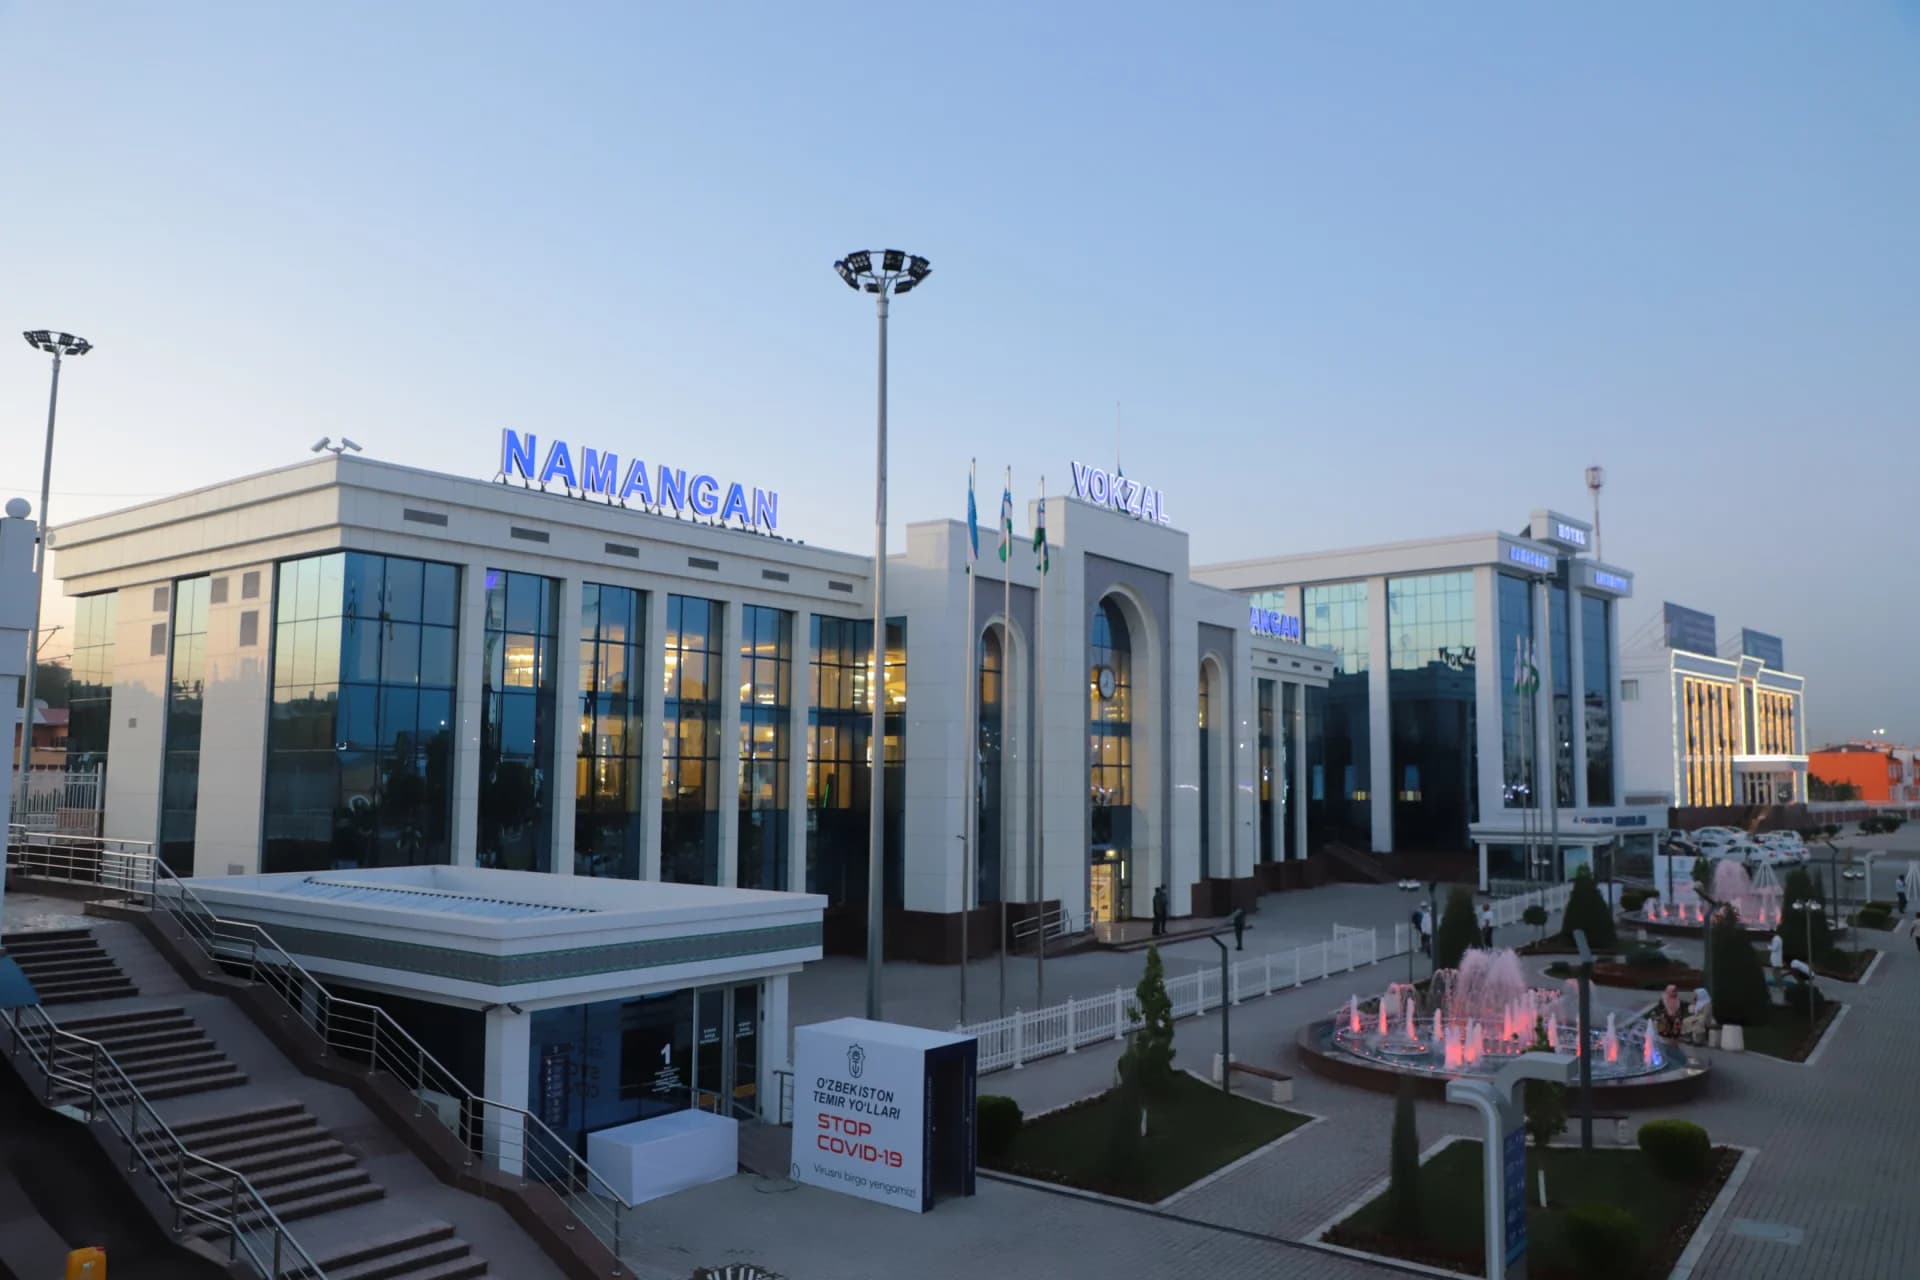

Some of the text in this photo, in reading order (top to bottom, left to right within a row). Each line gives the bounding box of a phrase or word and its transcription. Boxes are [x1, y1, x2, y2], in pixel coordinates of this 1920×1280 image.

[502, 428, 778, 529] NAMANGAN
[1071, 461, 1169, 523] VOKZAL
[1249, 607, 1299, 639] ANGAN
[660, 1043, 671, 1064] 1
[813, 1090, 901, 1120] TEMIR YO'LLARI
[816, 1077, 894, 1103] O'ZBEKISTON
[817, 1112, 872, 1136] STOP
[817, 1134, 903, 1168] COVID-19
